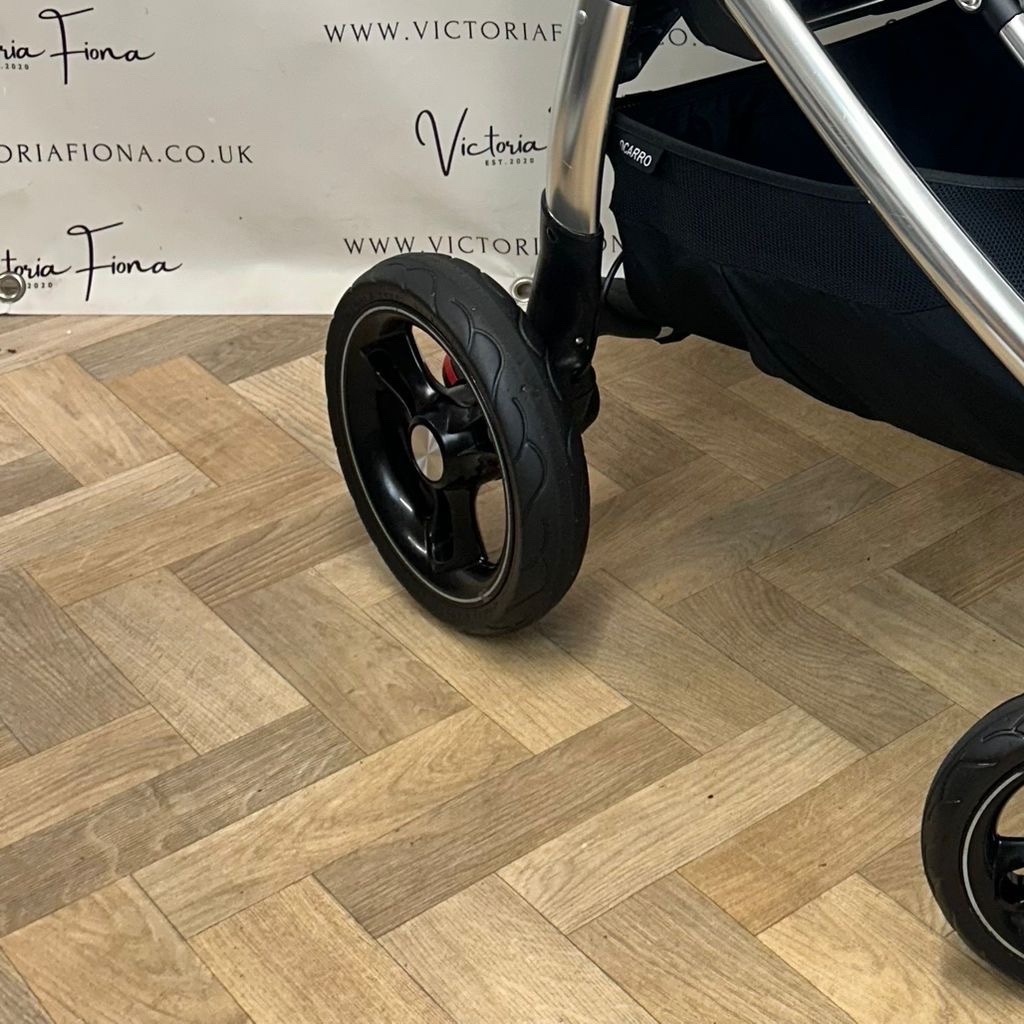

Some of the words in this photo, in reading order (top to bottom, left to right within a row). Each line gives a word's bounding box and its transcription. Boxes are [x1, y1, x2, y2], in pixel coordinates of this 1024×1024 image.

[38, 7, 155, 85] Fiona
[415, 107, 547, 176] Victoria
[66, 222, 183, 302] Fiona
